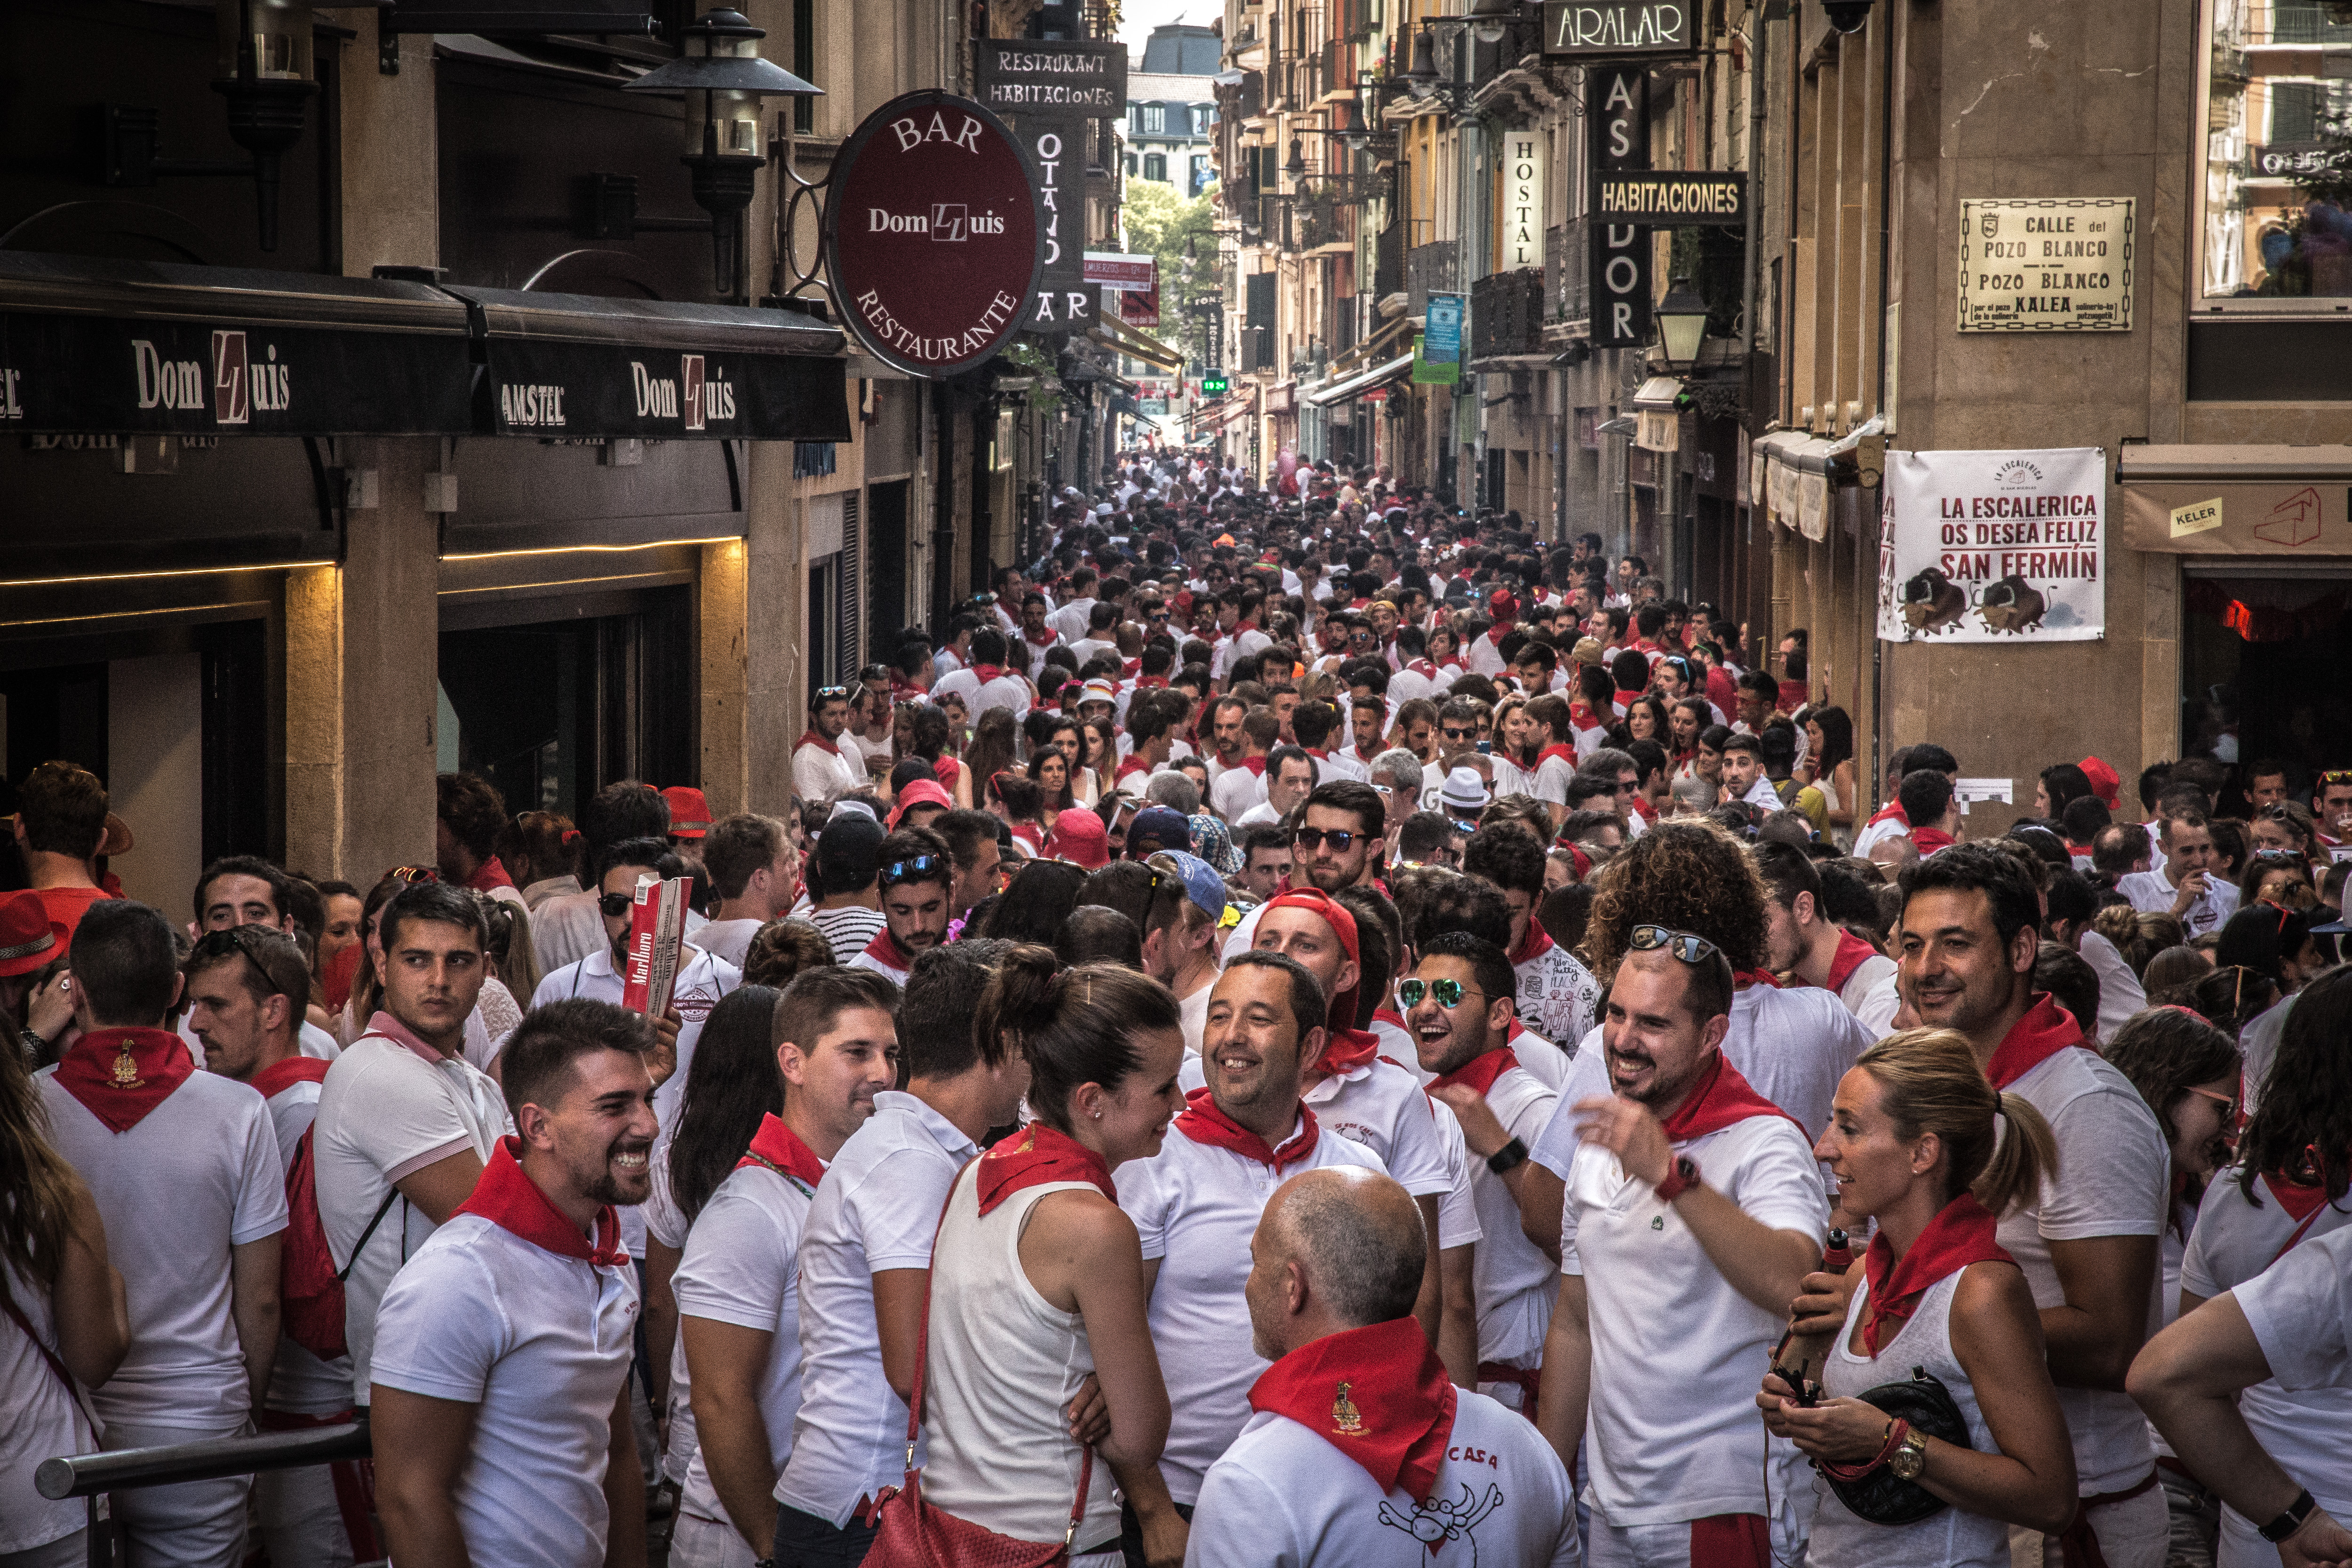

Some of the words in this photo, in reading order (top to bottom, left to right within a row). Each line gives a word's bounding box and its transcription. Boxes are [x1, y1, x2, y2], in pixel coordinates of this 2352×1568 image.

[1556, 4, 1682, 47] ARALAR
[998, 51, 1106, 73] RESTAURANT
[990, 84, 1114, 106] HABITACIONES
[890, 110, 983, 154] BAR
[1515, 141, 1534, 264] HOSTAL
[1602, 182, 1738, 213] HABITACIONES
[1604, 72, 1638, 339] ASDOR
[868, 208, 929, 233] Dom
[2025, 216, 2075, 233] CALLE
[2089, 221, 2106, 233] del
[1985, 241, 2026, 258] POZO
[2043, 240, 2107, 258] BLANCO
[1979, 274, 2024, 290] POZO
[2041, 273, 2110, 290] BLANCO
[2014, 296, 2072, 313] KALEA
[857, 288, 1017, 360] RESTAURANTE
[132, 339, 204, 409] Dom
[631, 361, 678, 418] Dom
[501, 384, 563, 426] AMSTEL
[1941, 498, 1964, 519] LA
[1972, 495, 2097, 518] ESCALERICA
[2176, 508, 2216, 525] KELER
[1941, 524, 1968, 545] OS
[1976, 522, 2039, 545] DESEA
[2045, 520, 2097, 543] FELIZ
[1941, 552, 1991, 580] SAN
[2001, 544, 2097, 579] FERMÍN
[630, 932, 652, 986] Marlboro
[1448, 1446, 1498, 1470] CASA
